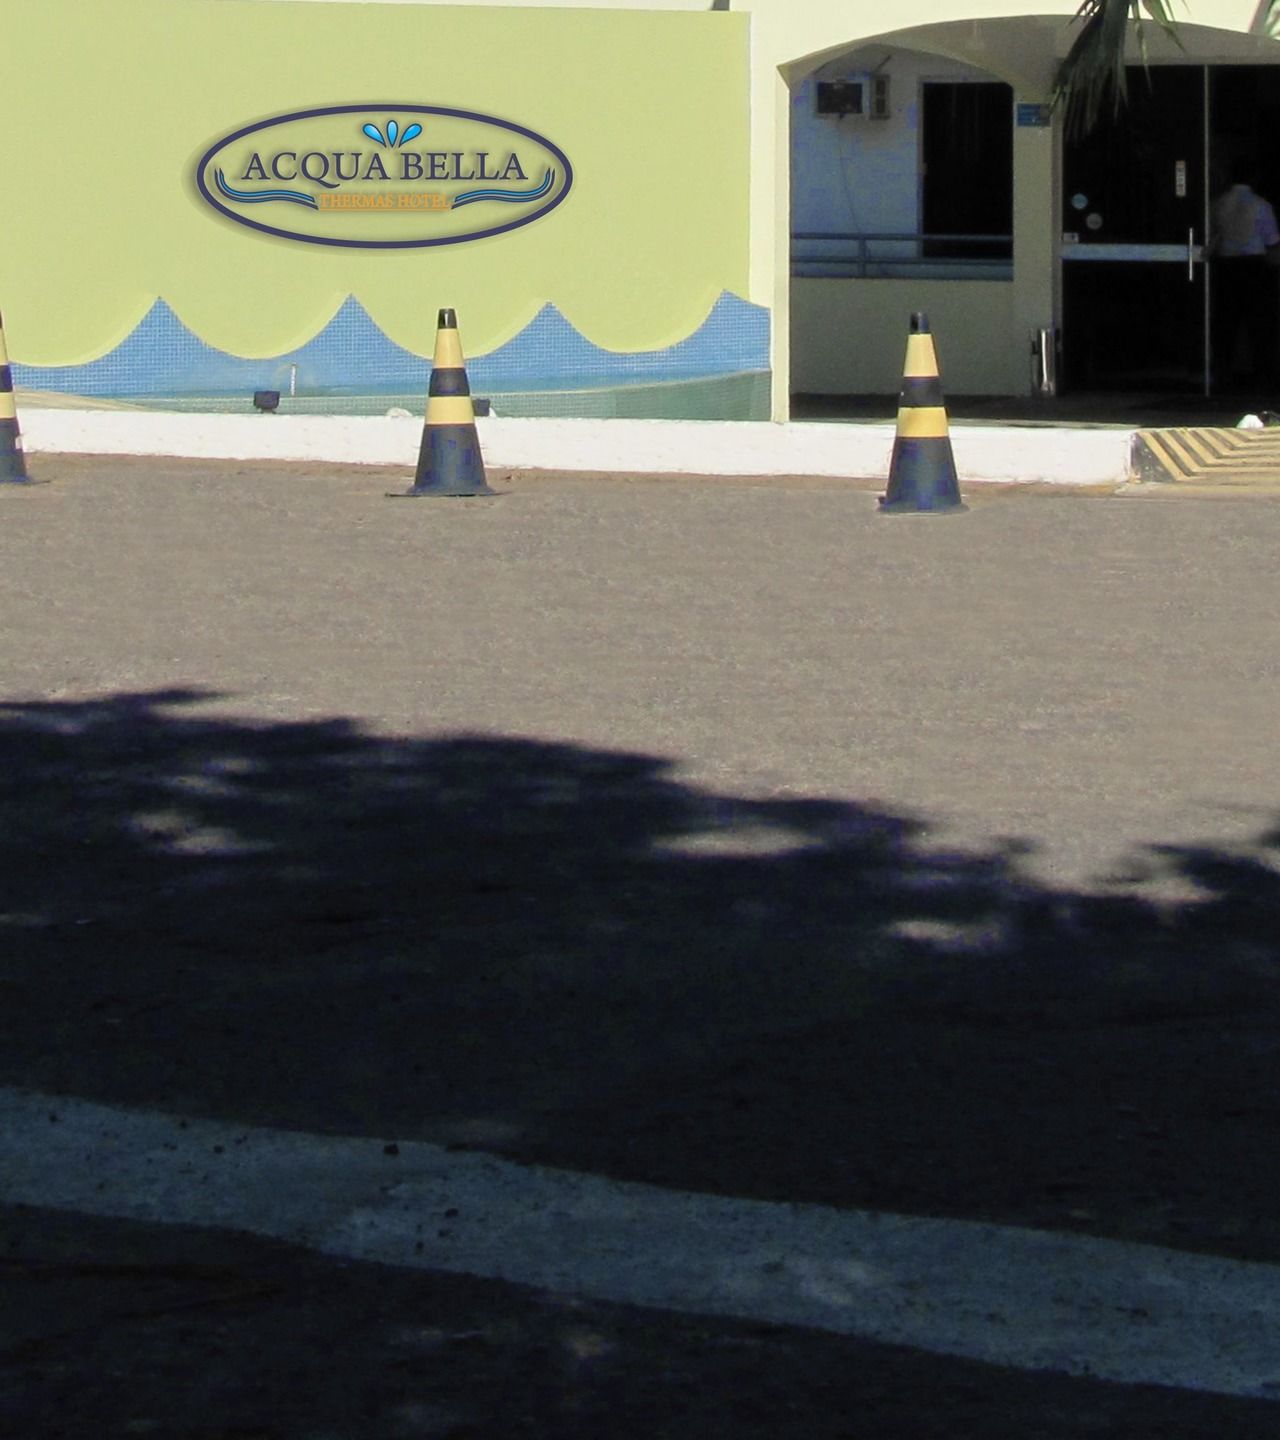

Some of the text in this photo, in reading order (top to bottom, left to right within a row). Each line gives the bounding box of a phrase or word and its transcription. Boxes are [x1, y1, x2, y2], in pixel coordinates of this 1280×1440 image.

[241, 152, 528, 188] ACQUA BELLA
[320, 192, 448, 209] THERMAS HOTEL
